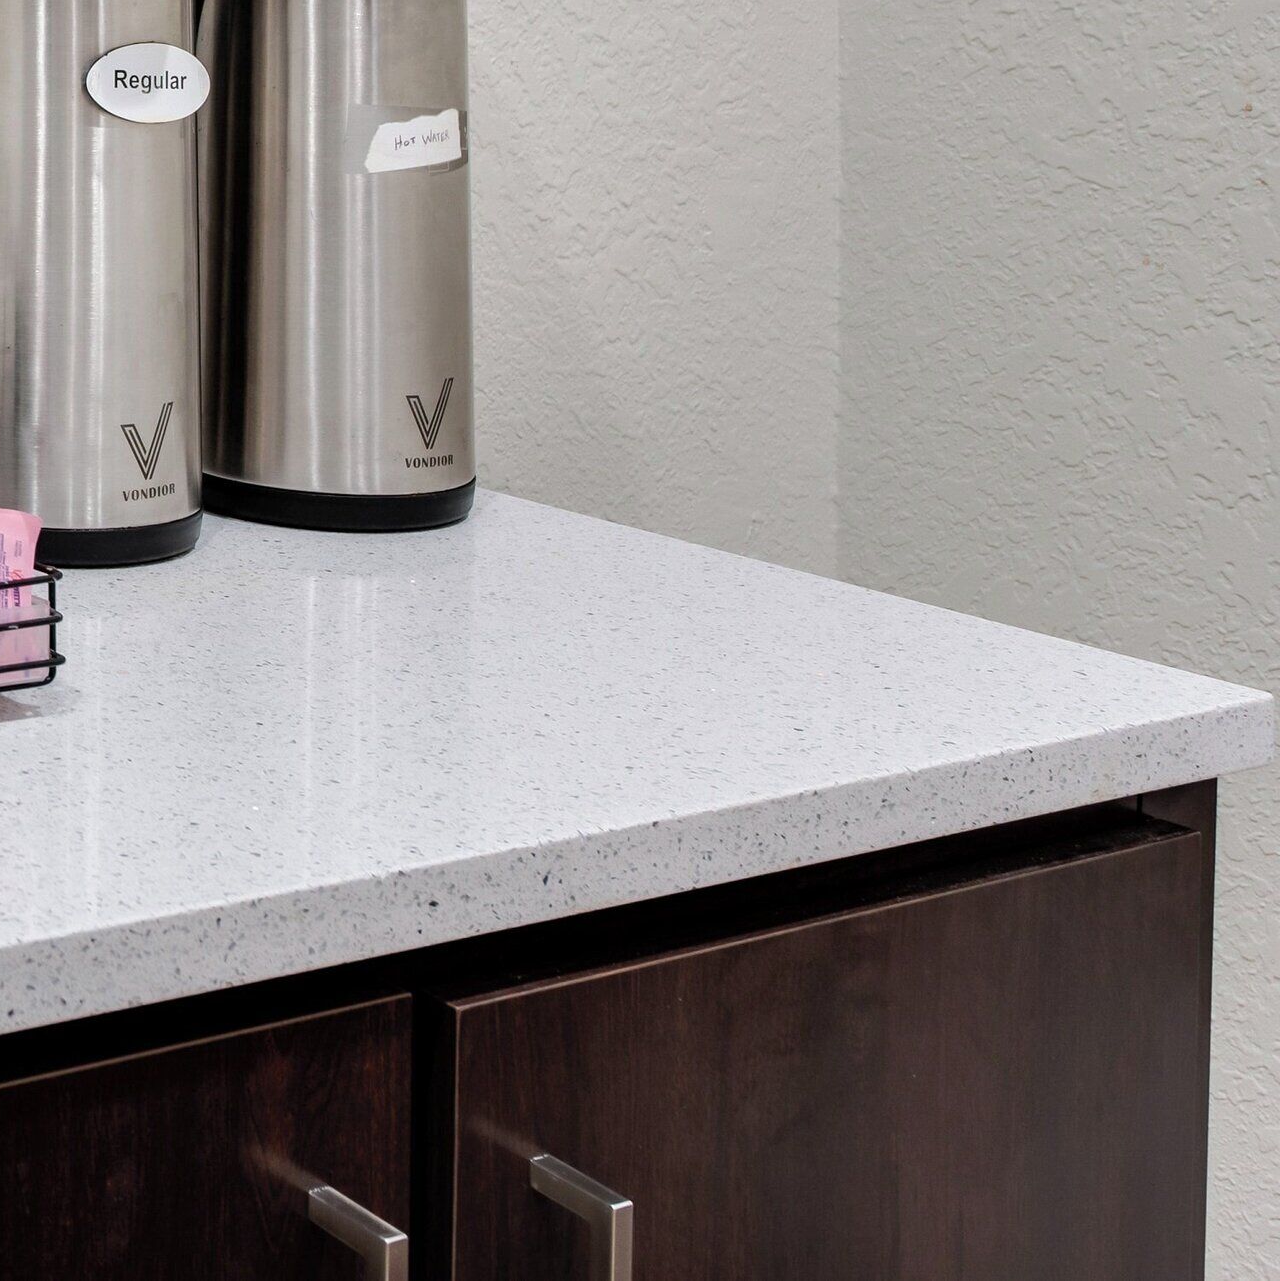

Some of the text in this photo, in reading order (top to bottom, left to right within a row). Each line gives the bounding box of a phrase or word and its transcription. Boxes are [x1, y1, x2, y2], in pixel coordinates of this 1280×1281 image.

[114, 69, 187, 94] Regular
[405, 454, 454, 469] VONDIOR
[122, 482, 176, 502] VONDIOR
